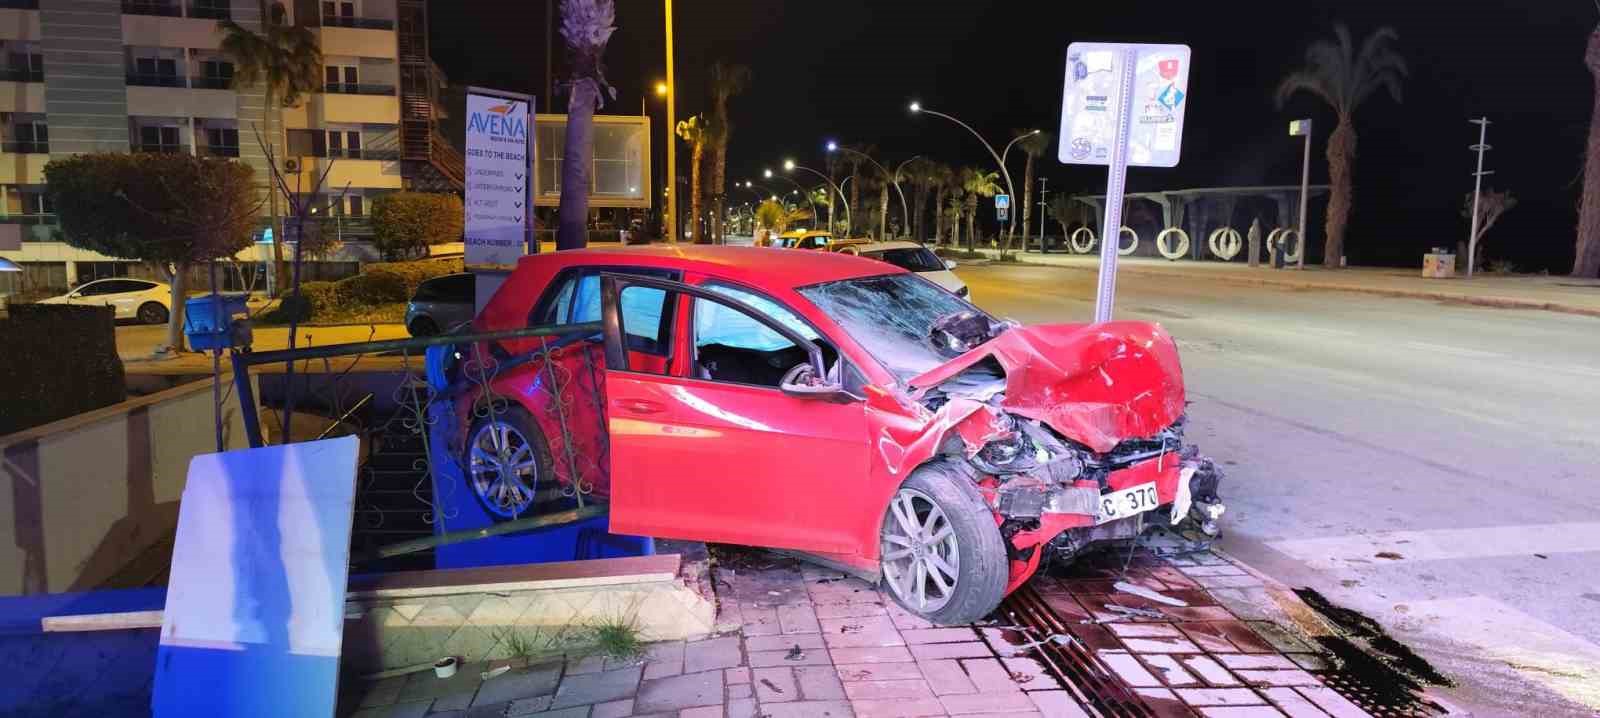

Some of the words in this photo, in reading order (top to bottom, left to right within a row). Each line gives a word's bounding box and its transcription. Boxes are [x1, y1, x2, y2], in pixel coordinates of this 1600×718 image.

[468, 111, 525, 138] AVENA
[485, 149, 493, 159] TO
[494, 151, 504, 160] THE
[505, 152, 525, 161] BEACH
[1125, 487, 1156, 510] 370
